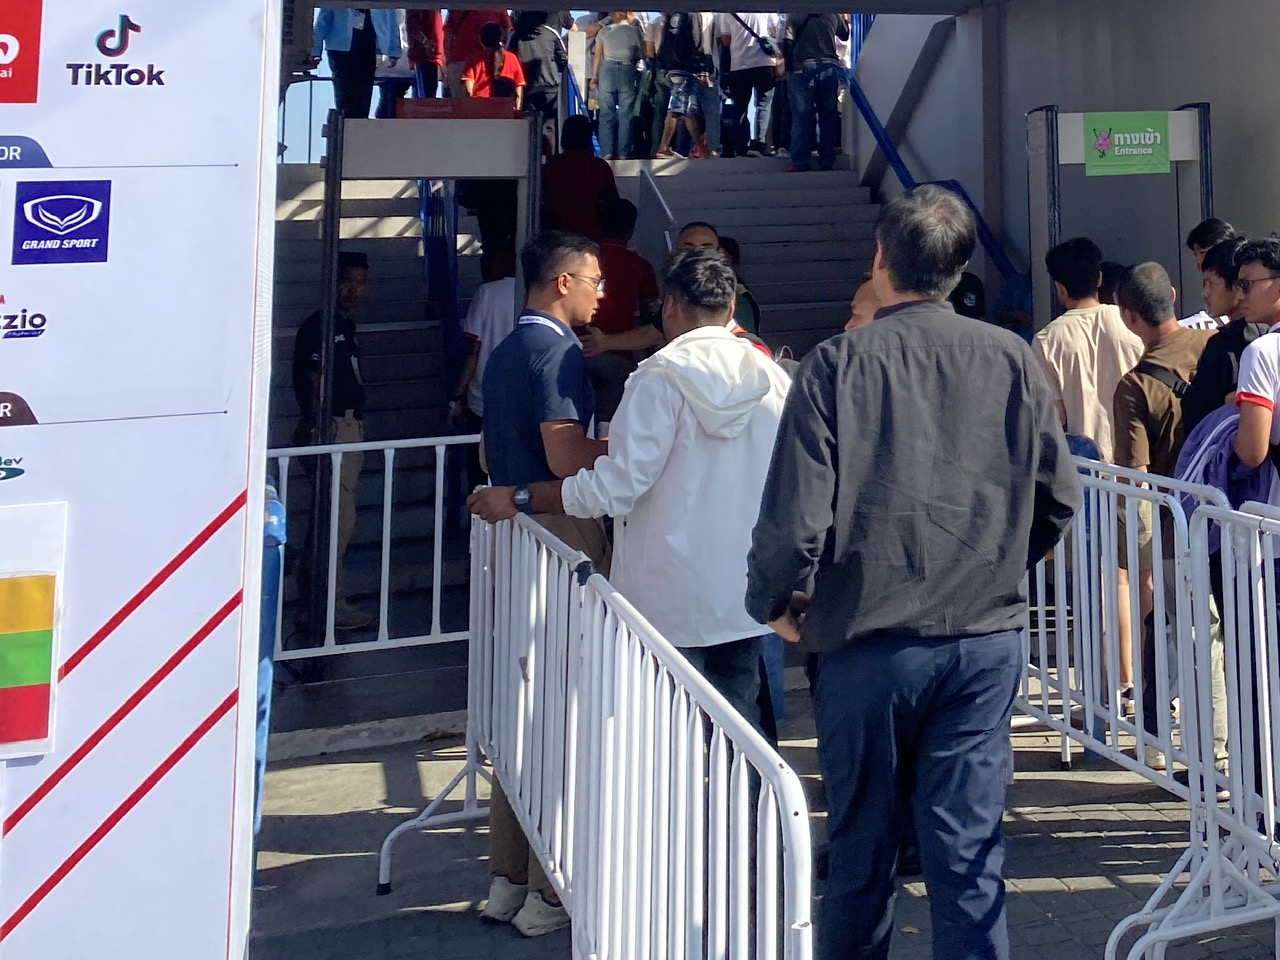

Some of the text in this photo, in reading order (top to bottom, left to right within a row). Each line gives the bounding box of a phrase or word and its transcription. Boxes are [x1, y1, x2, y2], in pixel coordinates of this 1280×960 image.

[66, 63, 165, 86] TikTok
[1114, 146, 1153, 156] Entrance
[22, 238, 99, 250] GRAND SPORT
